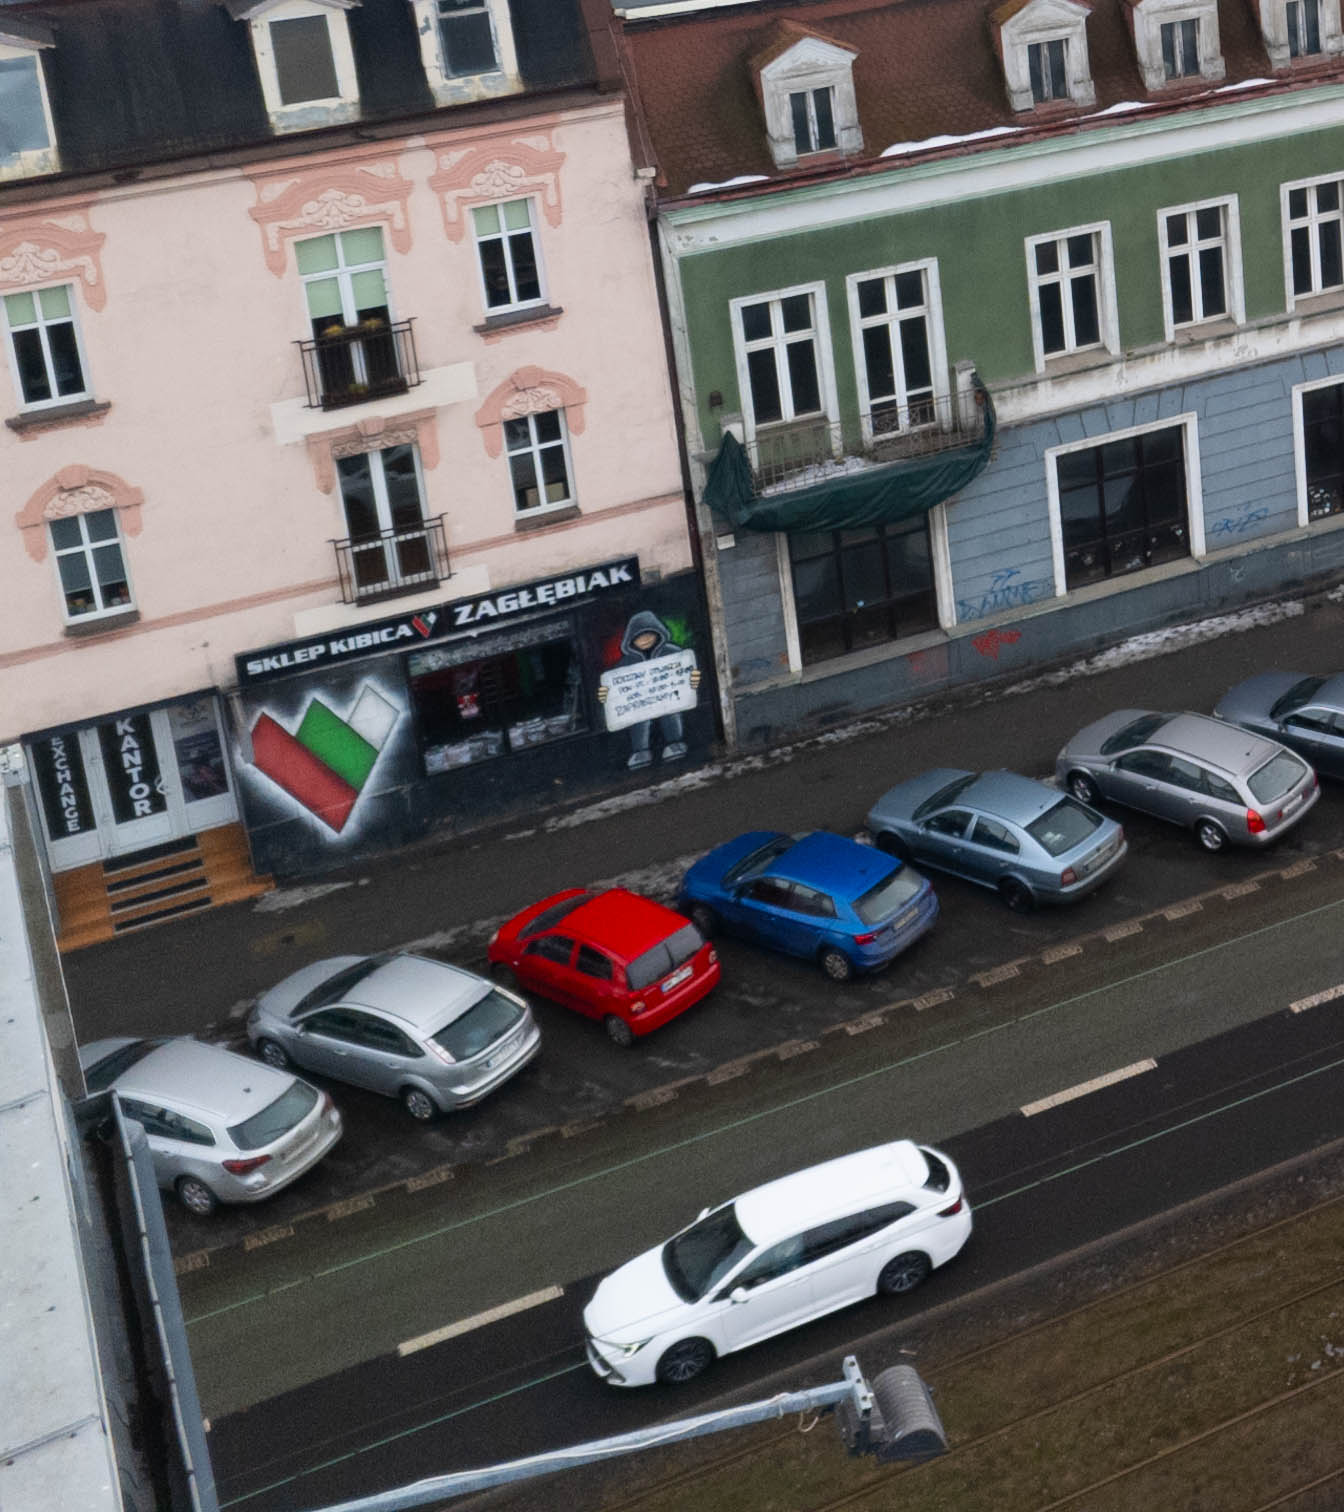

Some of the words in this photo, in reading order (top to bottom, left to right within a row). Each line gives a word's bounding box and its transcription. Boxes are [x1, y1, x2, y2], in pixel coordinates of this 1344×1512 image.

[246, 644, 326, 677] SKLEP
[330, 623, 414, 656] KIBICA
[453, 565, 633, 626] ZAGŁĘBIAK
[51, 737, 81, 833] EXCHANGE
[115, 716, 153, 817] KANTOR
